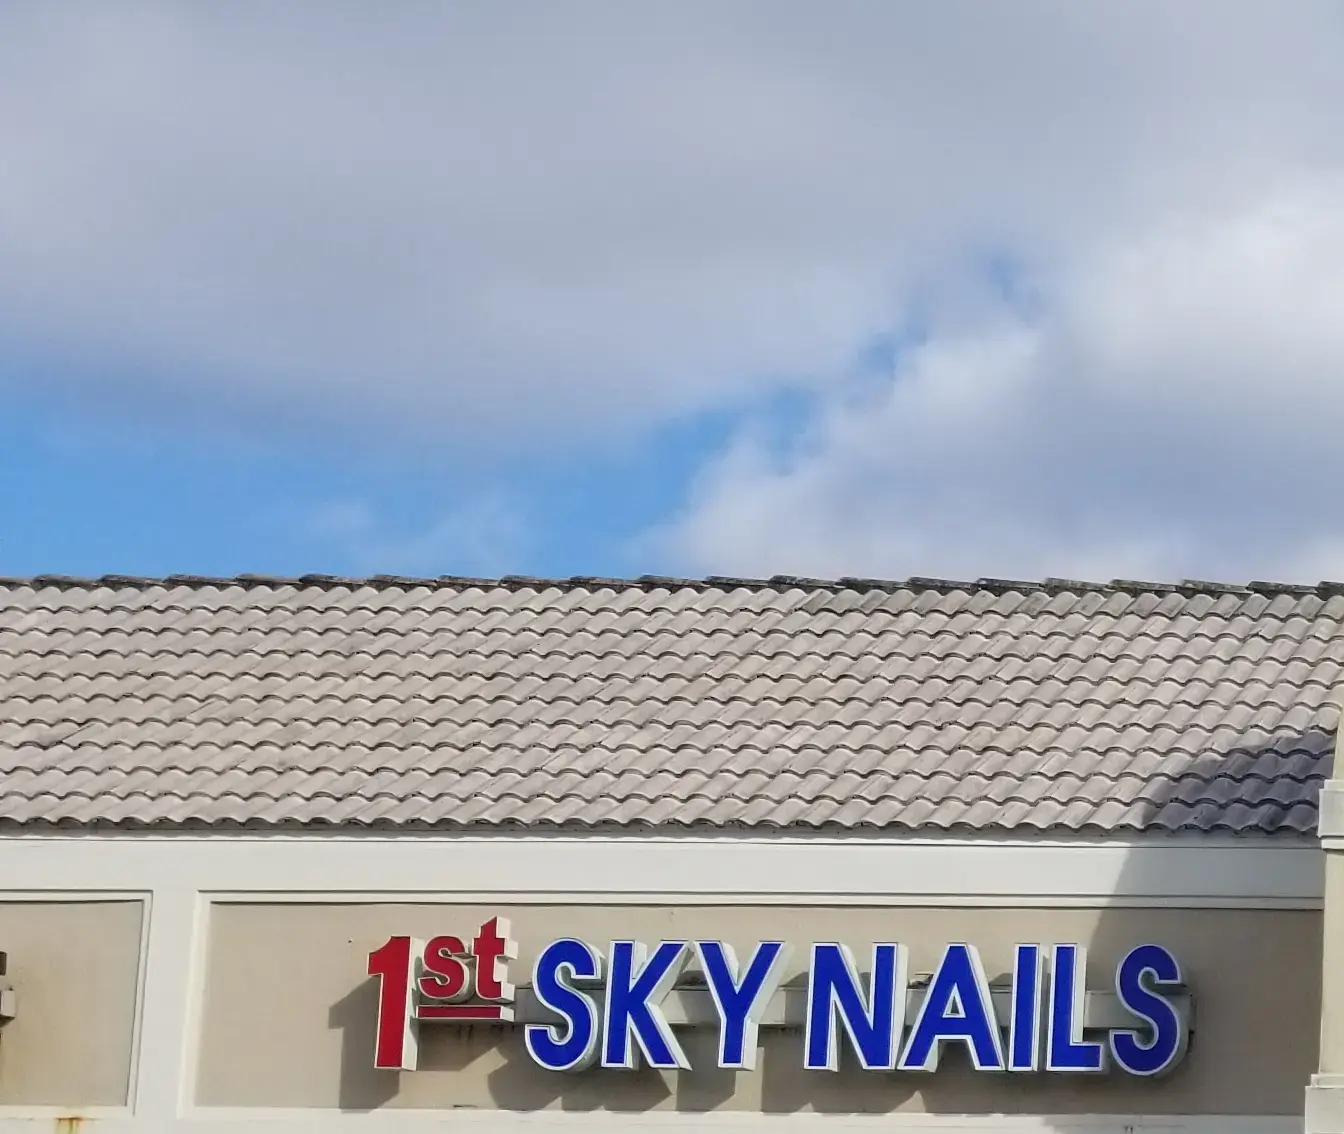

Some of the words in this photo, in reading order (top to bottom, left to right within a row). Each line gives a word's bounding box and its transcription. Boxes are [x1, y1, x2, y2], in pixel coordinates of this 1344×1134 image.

[366, 916, 515, 1071] 1st
[525, 938, 790, 1071] SKY
[804, 942, 1192, 1077] NAILS
